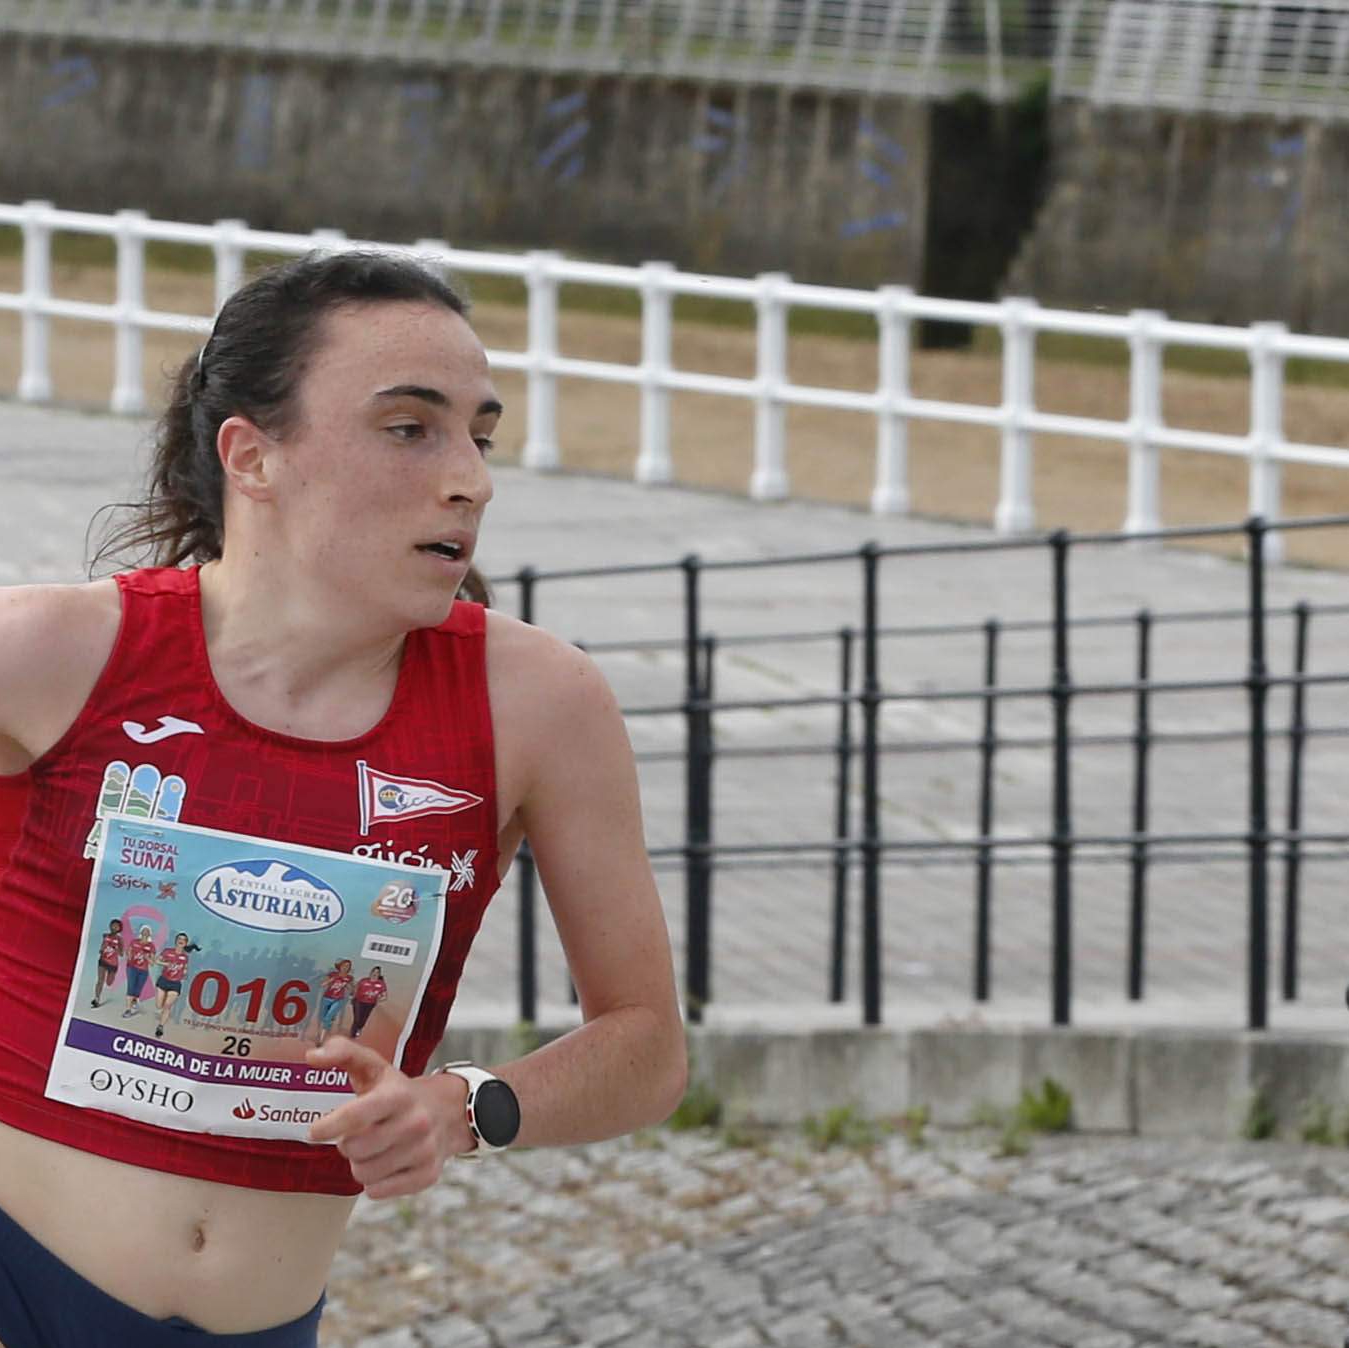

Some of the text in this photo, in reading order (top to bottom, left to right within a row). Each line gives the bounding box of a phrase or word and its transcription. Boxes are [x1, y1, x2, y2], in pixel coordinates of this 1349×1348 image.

[123, 836, 180, 856] TU DORSAL
[120, 848, 176, 873] SUMA
[230, 878, 279, 892] CENTRAL
[203, 876, 332, 923] ASTURIANA
[188, 969, 312, 1026] 016
[220, 1035, 252, 1057] 26
[112, 1036, 349, 1086] CARRERA DE LA MUJER GIJÓN
[89, 1068, 195, 1113] OYSHO
[258, 1104, 335, 1124] Santan
